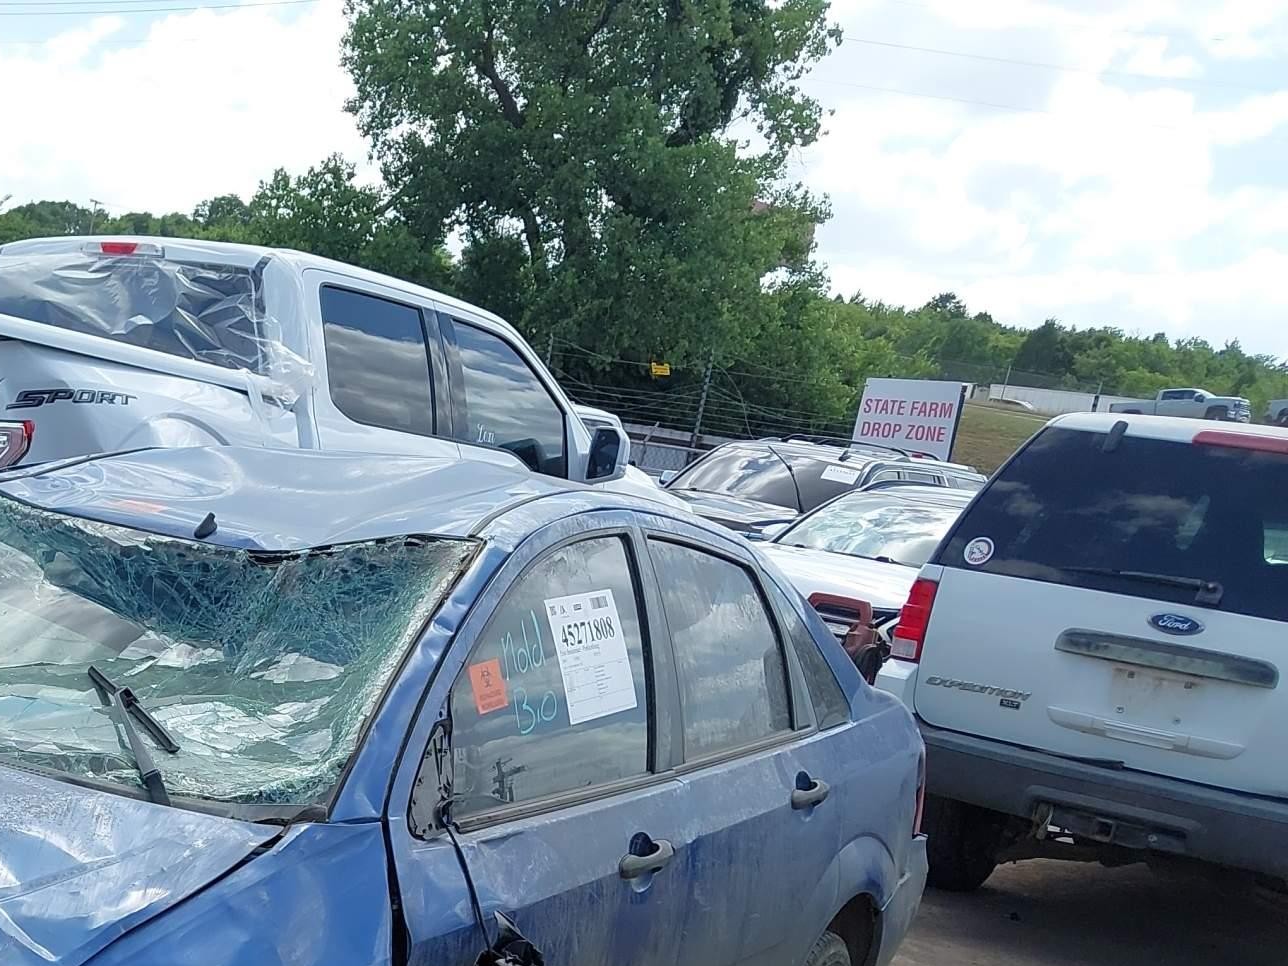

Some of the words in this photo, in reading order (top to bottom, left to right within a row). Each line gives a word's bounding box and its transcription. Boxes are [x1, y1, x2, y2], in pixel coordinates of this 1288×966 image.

[5, 388, 138, 410] SPORT
[863, 398, 907, 416] STATE
[910, 400, 954, 418] FARM
[860, 421, 902, 438] DROP
[905, 424, 947, 442] ZONE
[561, 615, 615, 648] 45271808
[1158, 614, 1192, 630] Ford
[926, 675, 1032, 701] EXPEDITION
